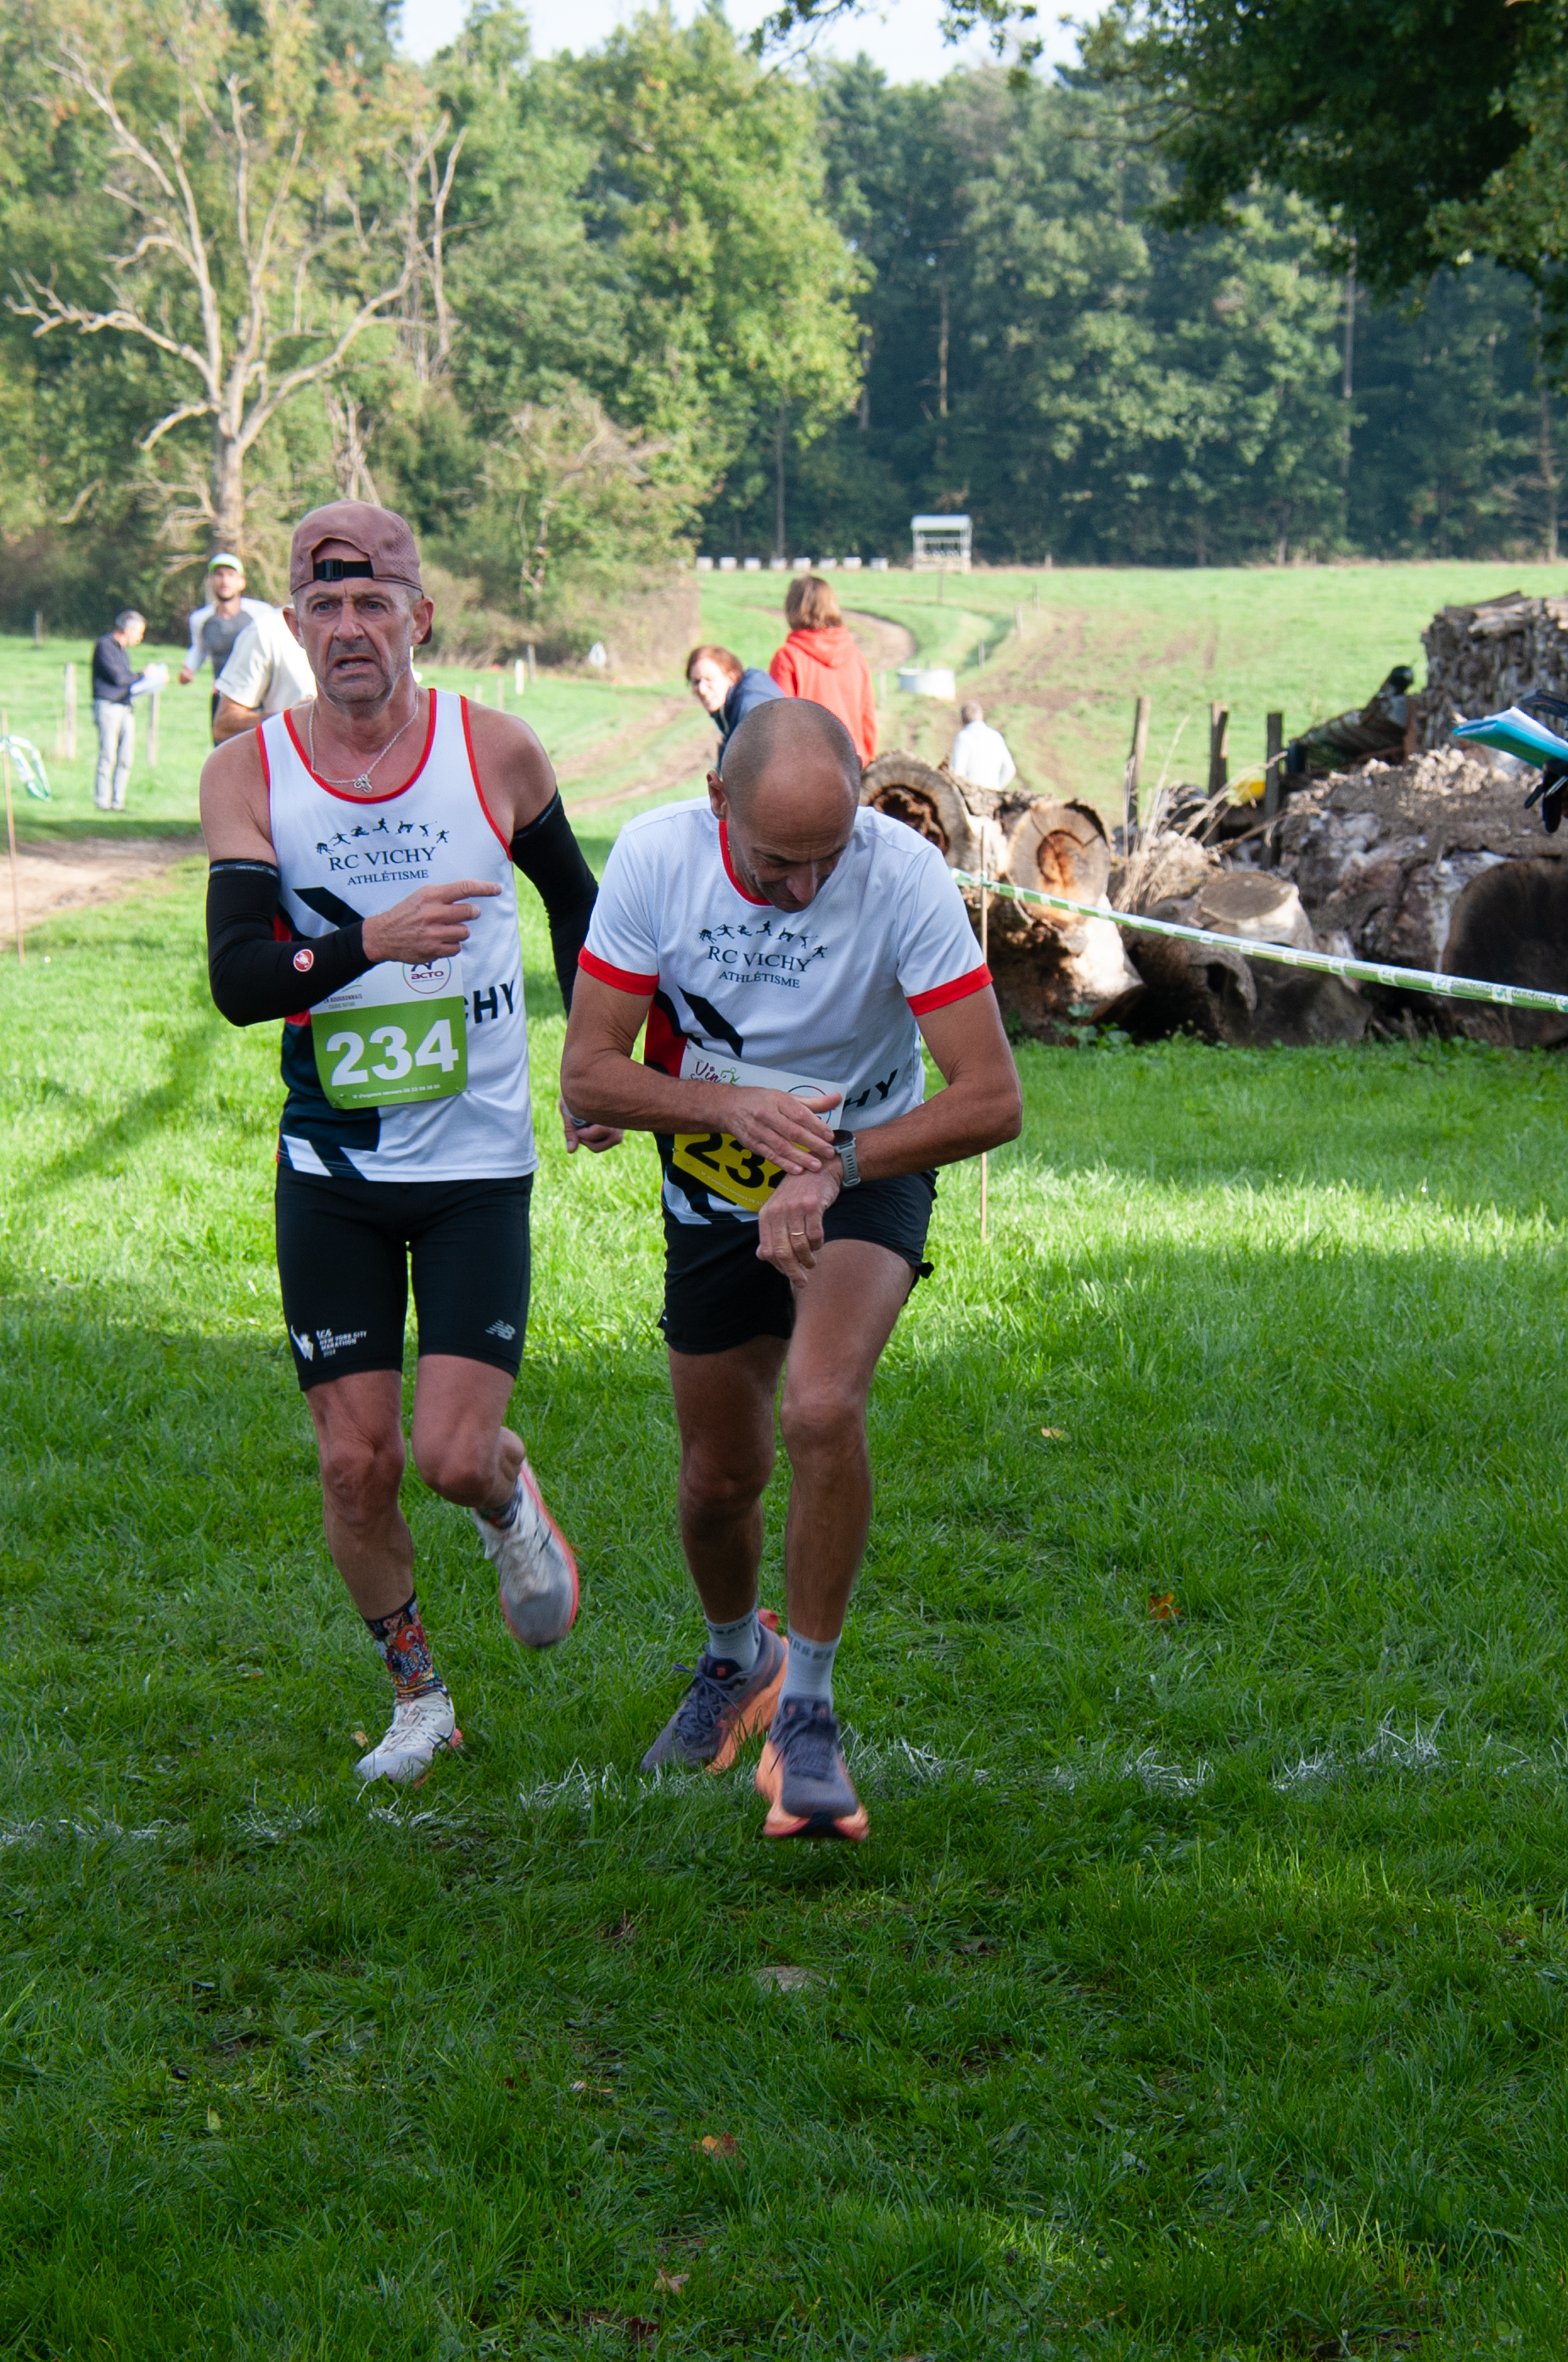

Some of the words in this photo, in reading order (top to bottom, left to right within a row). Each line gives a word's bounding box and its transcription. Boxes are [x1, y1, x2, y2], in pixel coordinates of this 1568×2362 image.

[329, 854, 359, 871] RC
[364, 847, 436, 866] VICHY
[347, 869, 429, 886] ATHLÉTISME
[707, 945, 738, 964] RC
[743, 952, 812, 972] VICHY
[718, 971, 801, 989] ATHLÉTISME
[326, 1018, 459, 1086] 234
[684, 1132, 784, 1189] 23
